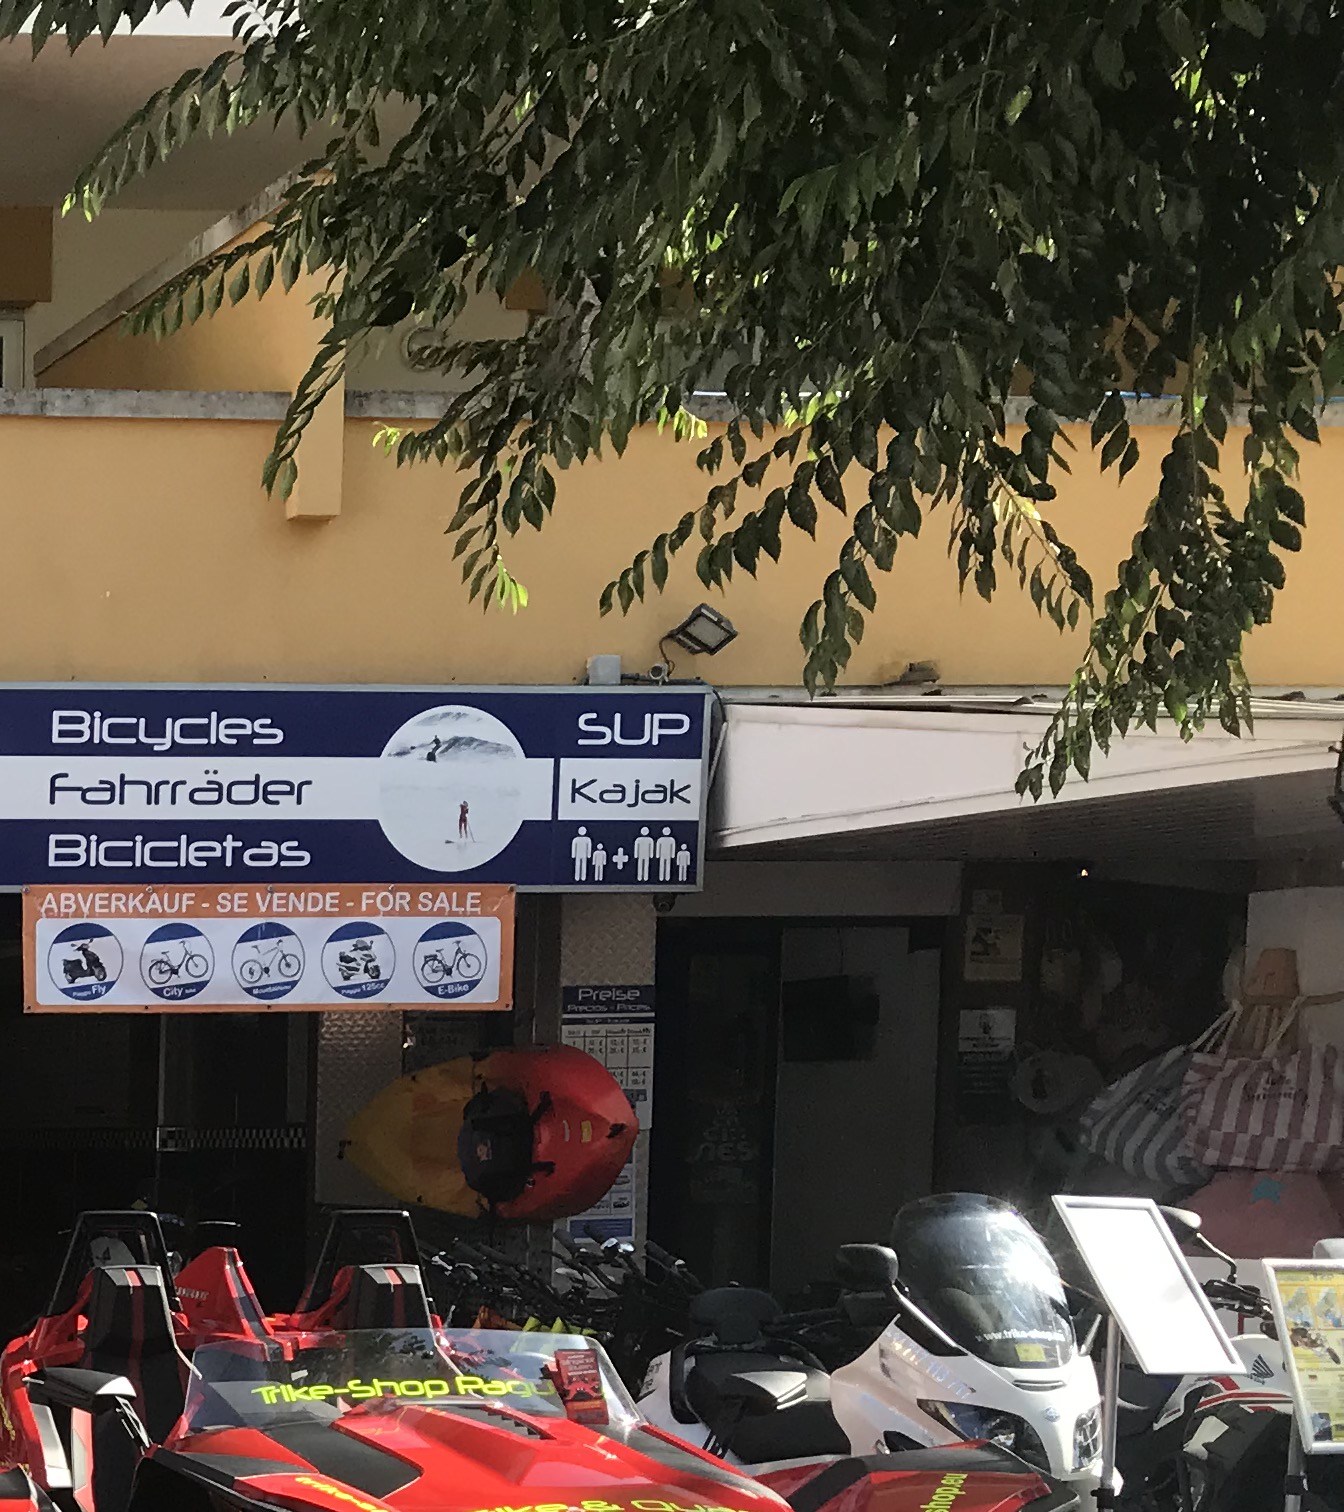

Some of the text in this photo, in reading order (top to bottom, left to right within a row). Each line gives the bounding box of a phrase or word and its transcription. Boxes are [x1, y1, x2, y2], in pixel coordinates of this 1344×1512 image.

[50, 709, 284, 752] Bicycles
[576, 711, 691, 747] SUP
[569, 777, 692, 808] Kajak
[47, 833, 311, 869] Bicicletas
[40, 892, 196, 915] ABVERKAUF
[216, 893, 253, 913] SE
[255, 893, 341, 913] VENDE
[360, 893, 413, 913] FOR
[416, 892, 482, 913] SALE
[162, 985, 184, 999] City
[436, 983, 470, 997] E-Bike
[577, 987, 641, 1001] Preise
[250, 1374, 557, 1405] Trike-Shop Pagu
